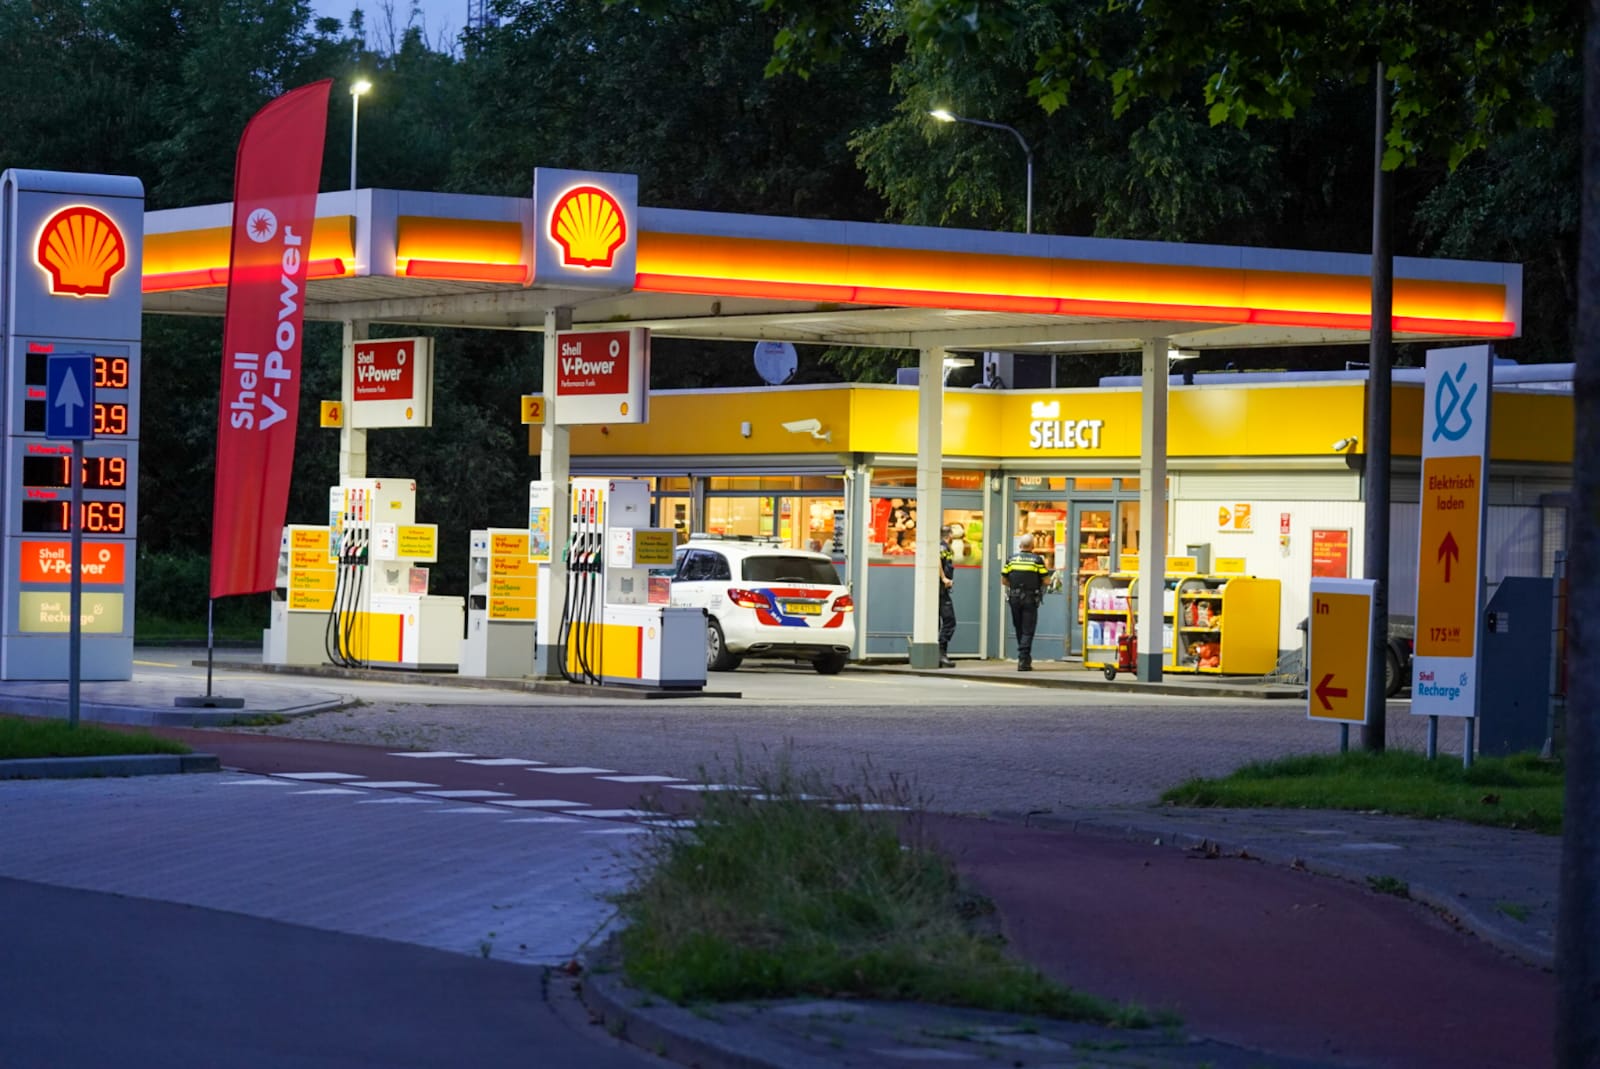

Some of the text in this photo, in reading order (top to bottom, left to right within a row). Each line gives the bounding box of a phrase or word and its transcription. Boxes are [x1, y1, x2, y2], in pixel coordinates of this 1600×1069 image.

[259, 225, 302, 431] V-Power
[561, 342, 582, 356] Shell
[357, 351, 375, 364] Shell
[357, 365, 402, 382] V-Power
[561, 357, 615, 376] V-Power
[230, 352, 259, 430] Shell
[329, 407, 339, 421] 4
[530, 402, 539, 417] 2
[1029, 420, 1103, 449] SELECT
[609, 482, 615, 491] 2
[1429, 473, 1475, 490] Elektrisch
[1437, 496, 1464, 511] laden
[39, 548, 65, 559] Shell
[1316, 598, 1329, 615] In
[1430, 628, 1447, 642] 175
[1418, 671, 1435, 681] Shell
[1418, 682, 1460, 701] Recharge
